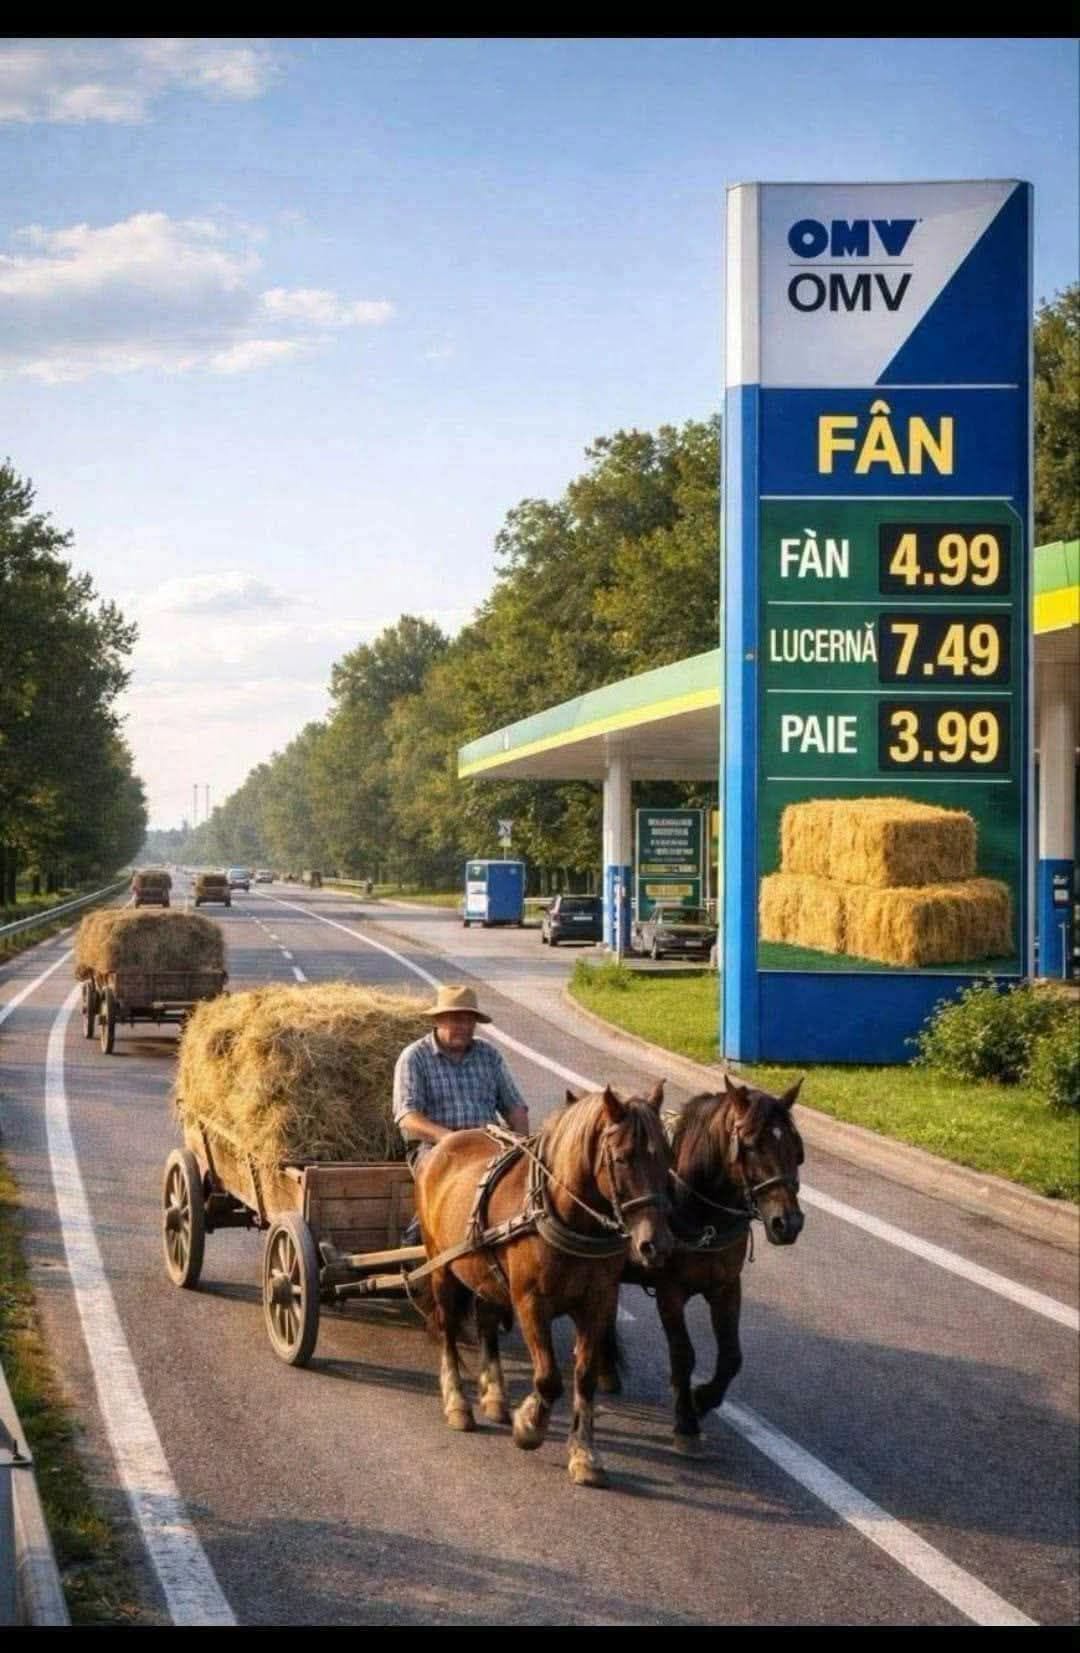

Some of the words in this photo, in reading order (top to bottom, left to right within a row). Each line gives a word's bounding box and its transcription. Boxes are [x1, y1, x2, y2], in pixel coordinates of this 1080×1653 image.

[788, 219, 917, 258] OMV
[788, 273, 912, 312] OMV
[818, 399, 955, 475] FÂN
[889, 533, 1000, 586] 4.99
[770, 622, 878, 663] LUCERNĂ
[890, 623, 1000, 676] 7.49
[780, 715, 858, 754] PAIE
[889, 710, 1000, 764] 3.99
